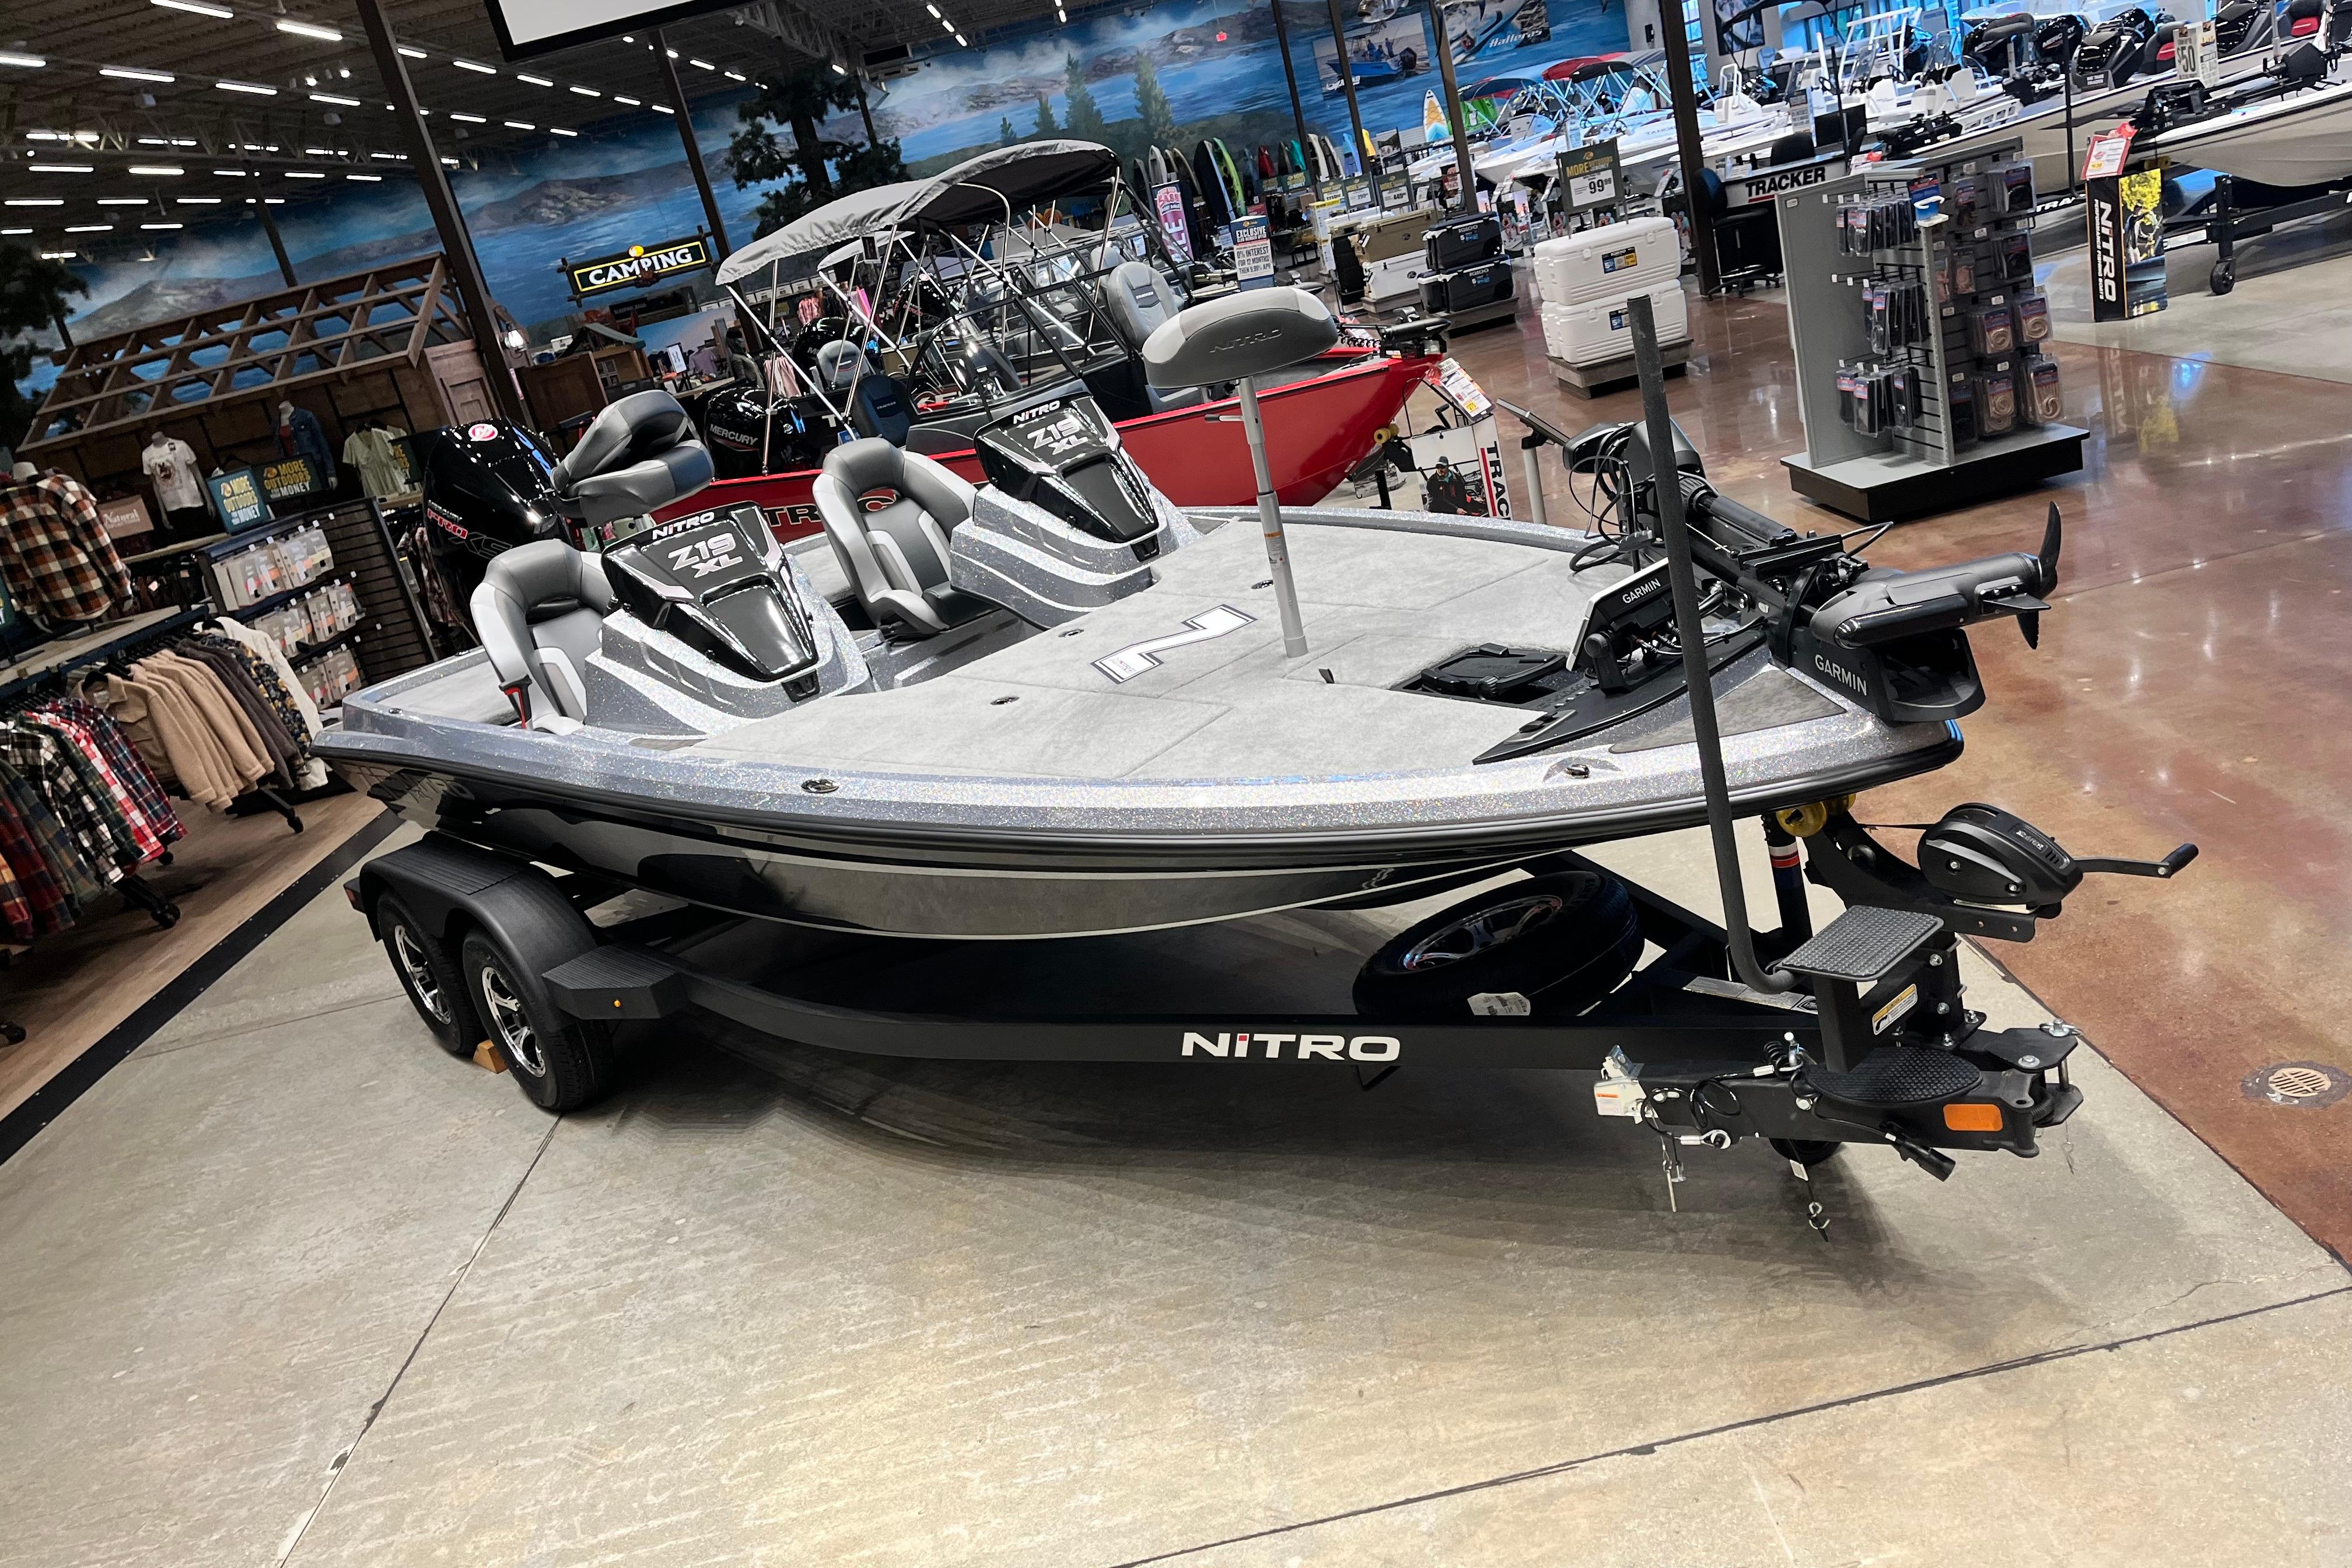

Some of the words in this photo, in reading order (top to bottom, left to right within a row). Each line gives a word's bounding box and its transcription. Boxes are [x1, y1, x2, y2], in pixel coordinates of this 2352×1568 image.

[2042, 26, 2076, 48] MERCRY
[1566, 162, 1590, 177] MORE
[1588, 179, 1605, 194] 99
[1745, 167, 1826, 197] TRACKER
[1236, 225, 1266, 239] EXCLUSIVE
[1245, 246, 1269, 257] INTEREST
[589, 248, 693, 285] CAMPING
[709, 423, 758, 447] MERCURY
[1027, 417, 1080, 449] Z19
[1048, 435, 1088, 456] XL
[279, 459, 306, 475] MORE
[279, 482, 311, 497] MONEY
[1486, 441, 1512, 520] TRAC
[428, 508, 468, 540] PRO
[668, 533, 736, 570] Z19
[691, 554, 743, 578] XL
[1622, 578, 1661, 604] GARMIN
[1815, 654, 1867, 696] GARMIN
